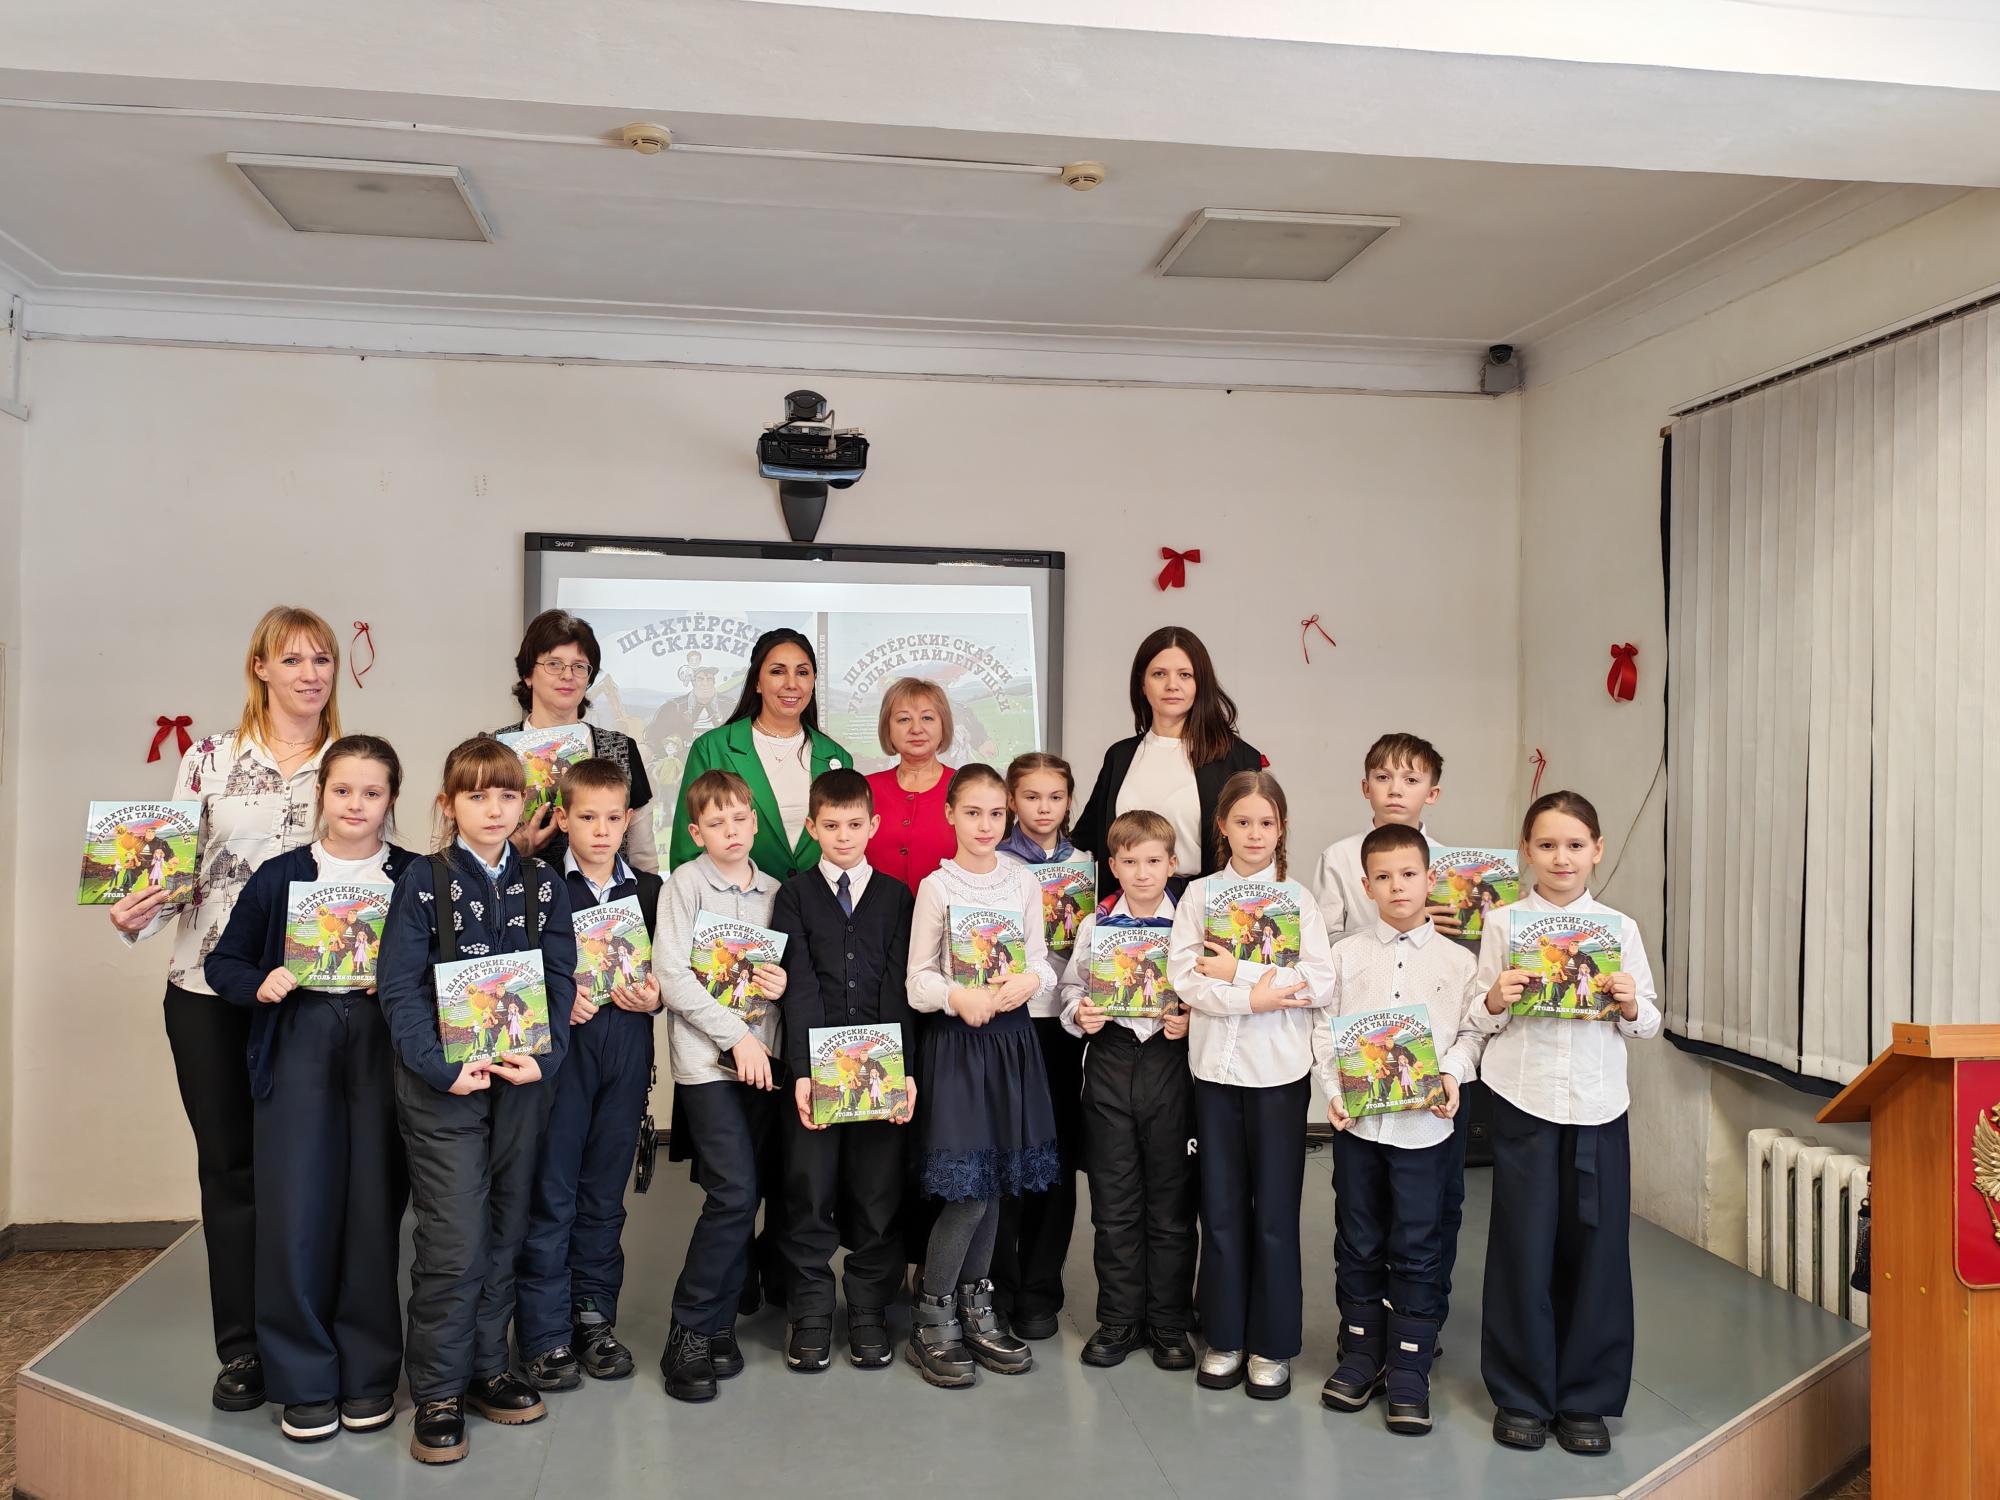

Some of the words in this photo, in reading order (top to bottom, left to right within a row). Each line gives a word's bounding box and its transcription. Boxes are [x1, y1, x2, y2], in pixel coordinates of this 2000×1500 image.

[554, 540, 575, 548] SMART
[652, 633, 749, 658] СКАЗКИ
[842, 633, 950, 686] ШАХТЁРСКИЕ
[953, 638, 1014, 685] СКАЗКИ
[848, 653, 907, 714] УГОЛЬКА
[910, 647, 1011, 712] ТАЙЛЕПУШКИ
[95, 815, 134, 844] УГОЛЬКА
[162, 806, 195, 831] СКАЗКИ
[1066, 867, 1092, 886] СКАЗКИ
[1484, 853, 1516, 876] СКАЗКИ
[298, 896, 334, 925] УГОЛЬКА
[1213, 893, 1244, 919] УГОЛЬКА
[1267, 886, 1297, 910] СКАЗКИ
[608, 906, 641, 922] СКАЗКИ
[997, 915, 1022, 936] СКАЗКИ
[696, 930, 731, 951] УГОЛЬКА
[958, 921, 981, 944] УГОЛЬКА
[1520, 924, 1555, 954] УГОЛЬКА
[1582, 919, 1618, 945] СКАЗКИ
[755, 931, 779, 959] СКАЗКИ
[1098, 938, 1127, 963] УГОЛЬКА
[506, 960, 541, 980] СКАЗКИ
[448, 972, 480, 1008] УГОЛЬКА
[1392, 1013, 1427, 1033] СКАЗКИ
[869, 1029, 900, 1050] СКАЗКИ
[1344, 1025, 1370, 1057] УГОЛЬКА
[819, 1039, 847, 1068] УГОЛЬКА
